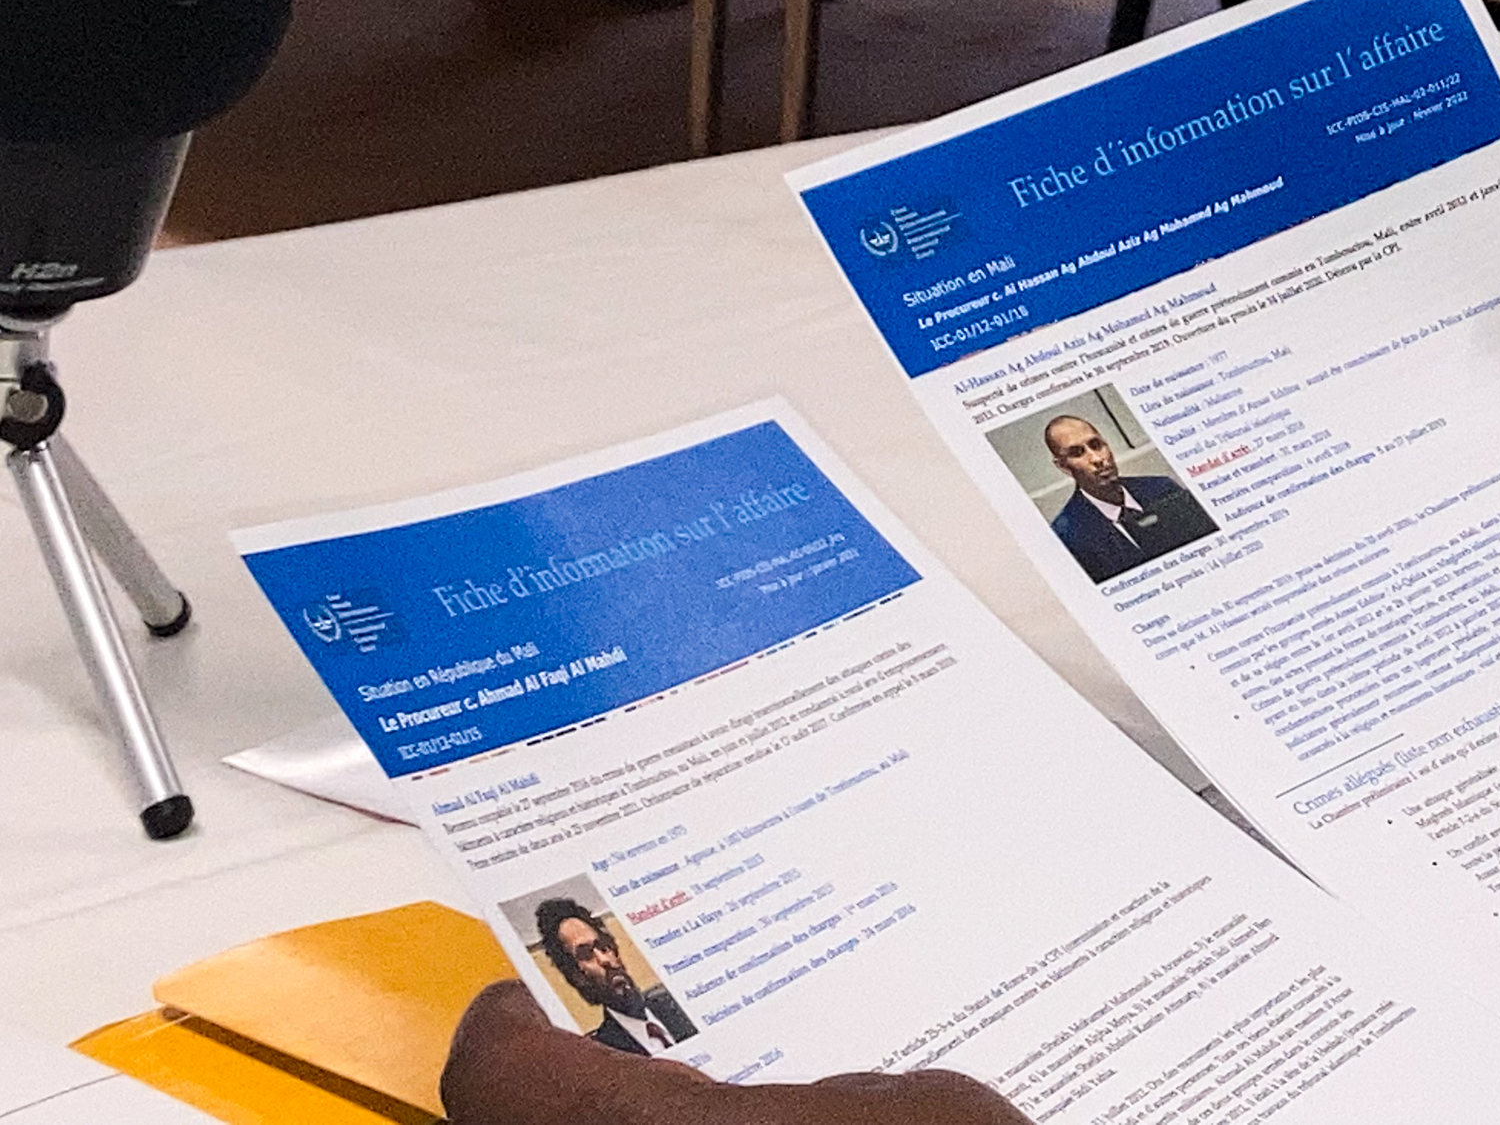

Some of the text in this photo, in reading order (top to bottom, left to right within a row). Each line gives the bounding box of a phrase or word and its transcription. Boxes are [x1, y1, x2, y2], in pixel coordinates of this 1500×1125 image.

[1009, 165, 1087, 207] Fiche
[1289, 68, 1332, 99] sur
[902, 256, 1016, 307] Situation en Mali
[917, 176, 1283, 329] Le Procureur c. Al Hassan Ag Abdoul Aziz Ag Mohamed Ag Mahmoud
[930, 305, 1028, 350] ICC-01/12-01/18
[433, 579, 508, 616] Fiche
[674, 516, 715, 545] sur
[358, 641, 540, 702] Situation en République du Mali
[378, 646, 626, 733] Le Procureur c. Ahmad Al Faqi Al Mahdi
[1292, 787, 1343, 815] Crimes
[1343, 760, 1396, 792] allégués
[1393, 745, 1428, 767] (liste
[1426, 731, 1454, 750] non
